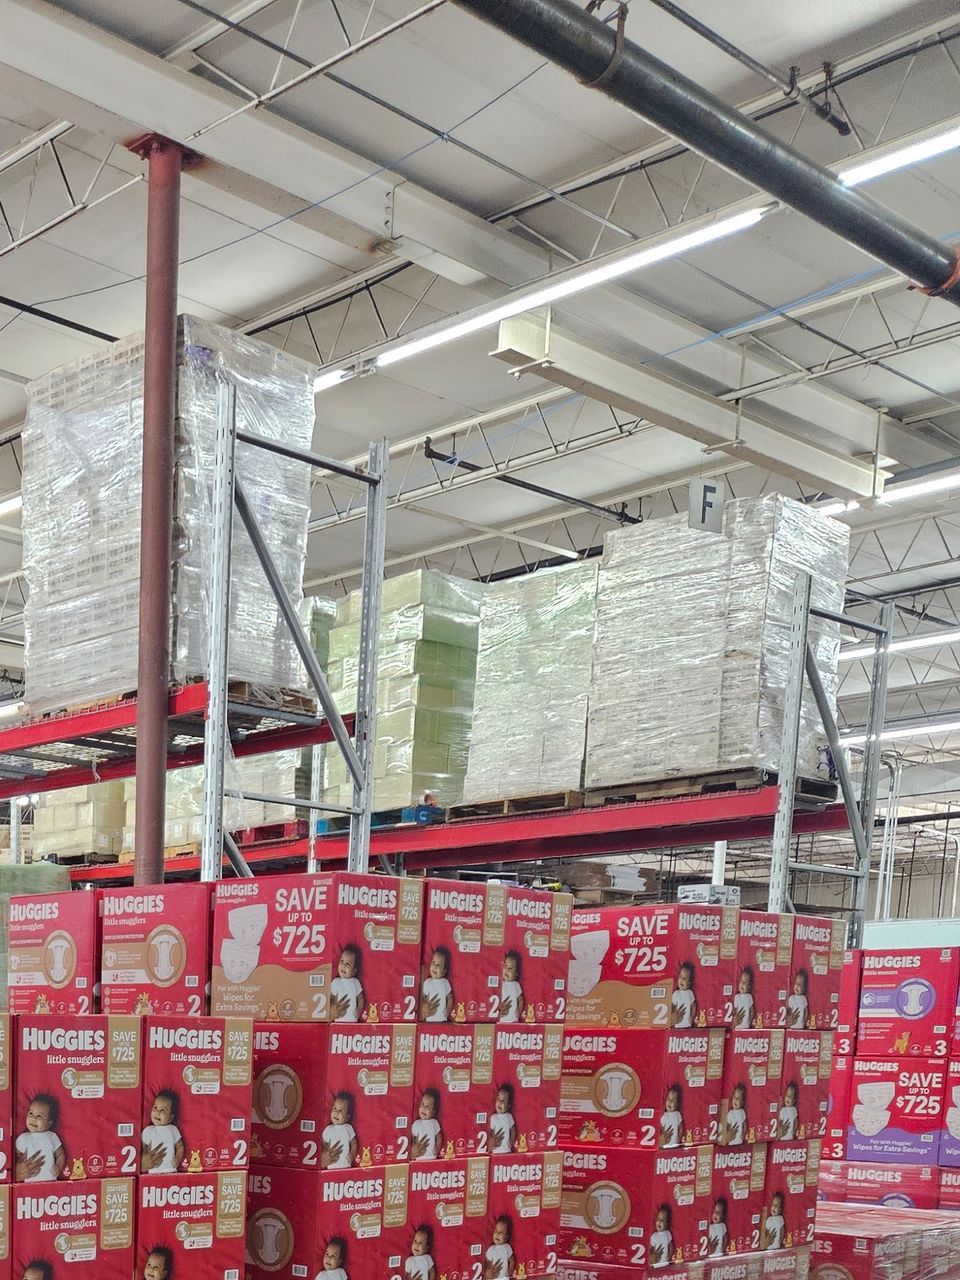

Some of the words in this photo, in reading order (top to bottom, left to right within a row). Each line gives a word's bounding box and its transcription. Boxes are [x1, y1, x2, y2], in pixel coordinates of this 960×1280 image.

[701, 485, 716, 524] F
[104, 894, 165, 916] HUGGIES
[275, 886, 327, 912] SAVE
[338, 883, 397, 909] HUGGIES
[430, 889, 484, 913] HUGGIES
[288, 912, 299, 923] UP
[300, 912, 312, 922] TO
[617, 915, 668, 936] SAVE
[679, 913, 720, 931] HUGGIES
[273, 924, 326, 955] $725
[629, 937, 640, 945] UP
[642, 936, 654, 945] TO
[615, 946, 667, 972] $725
[864, 956, 921, 968] HUGGIES
[311, 993, 327, 1019] 2
[653, 1004, 668, 1025] 2
[22, 1027, 105, 1051] HUGGIES
[112, 1031, 137, 1042] SAVE
[149, 1027, 222, 1050] HUGGIES
[331, 1034, 390, 1054] HUGGIES
[496, 1032, 543, 1050] HUGGIES
[111, 1047, 135, 1062] $725
[170, 1052, 188, 1062] little
[188, 1053, 221, 1063] snugglers
[935, 1039, 947, 1056] 3
[899, 1072, 942, 1087] SAVE
[896, 1095, 941, 1114] $725
[121, 1145, 137, 1174] 2
[831, 1143, 843, 1157] 3
[656, 1156, 696, 1175] HUGGIES
[848, 1168, 902, 1182] HUGGIES
[221, 1184, 243, 1196] SAVE
[412, 1171, 465, 1191] HUGGIES
[16, 1194, 97, 1219] HUGGIES
[142, 1185, 214, 1208] HUGGIES
[221, 1200, 241, 1214] $725
[40, 1220, 59, 1231] little
[60, 1219, 97, 1229] snugglers
[631, 1243, 646, 1264] 2
